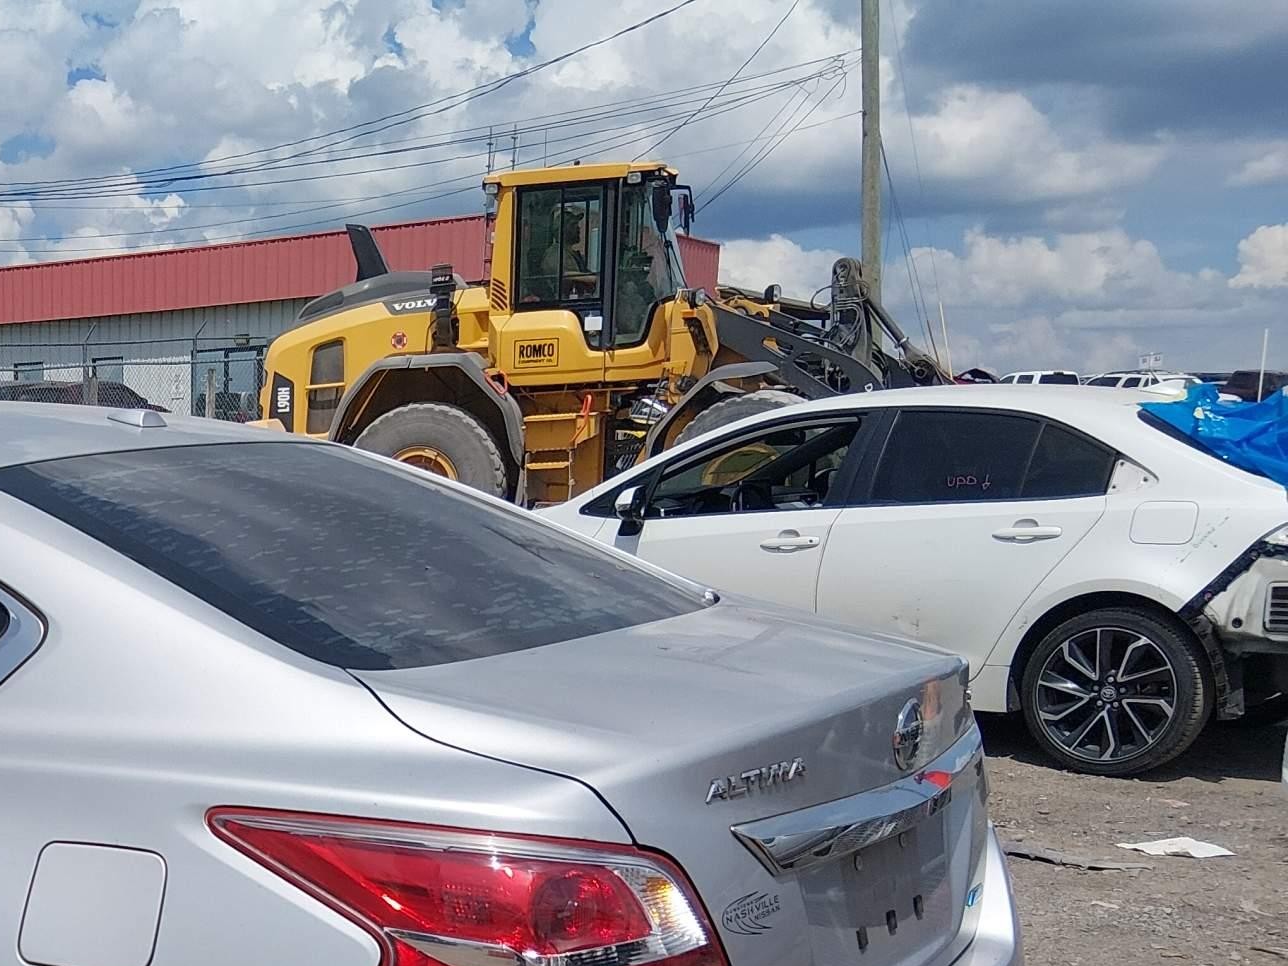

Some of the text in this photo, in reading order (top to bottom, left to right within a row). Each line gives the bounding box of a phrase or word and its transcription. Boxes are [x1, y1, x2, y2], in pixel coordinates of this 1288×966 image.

[392, 298, 438, 311] VOLV
[519, 342, 555, 359] ROMCO
[277, 387, 290, 412] L90H
[705, 757, 806, 804] ALTIMA
[725, 894, 781, 925] NASHVILLE
